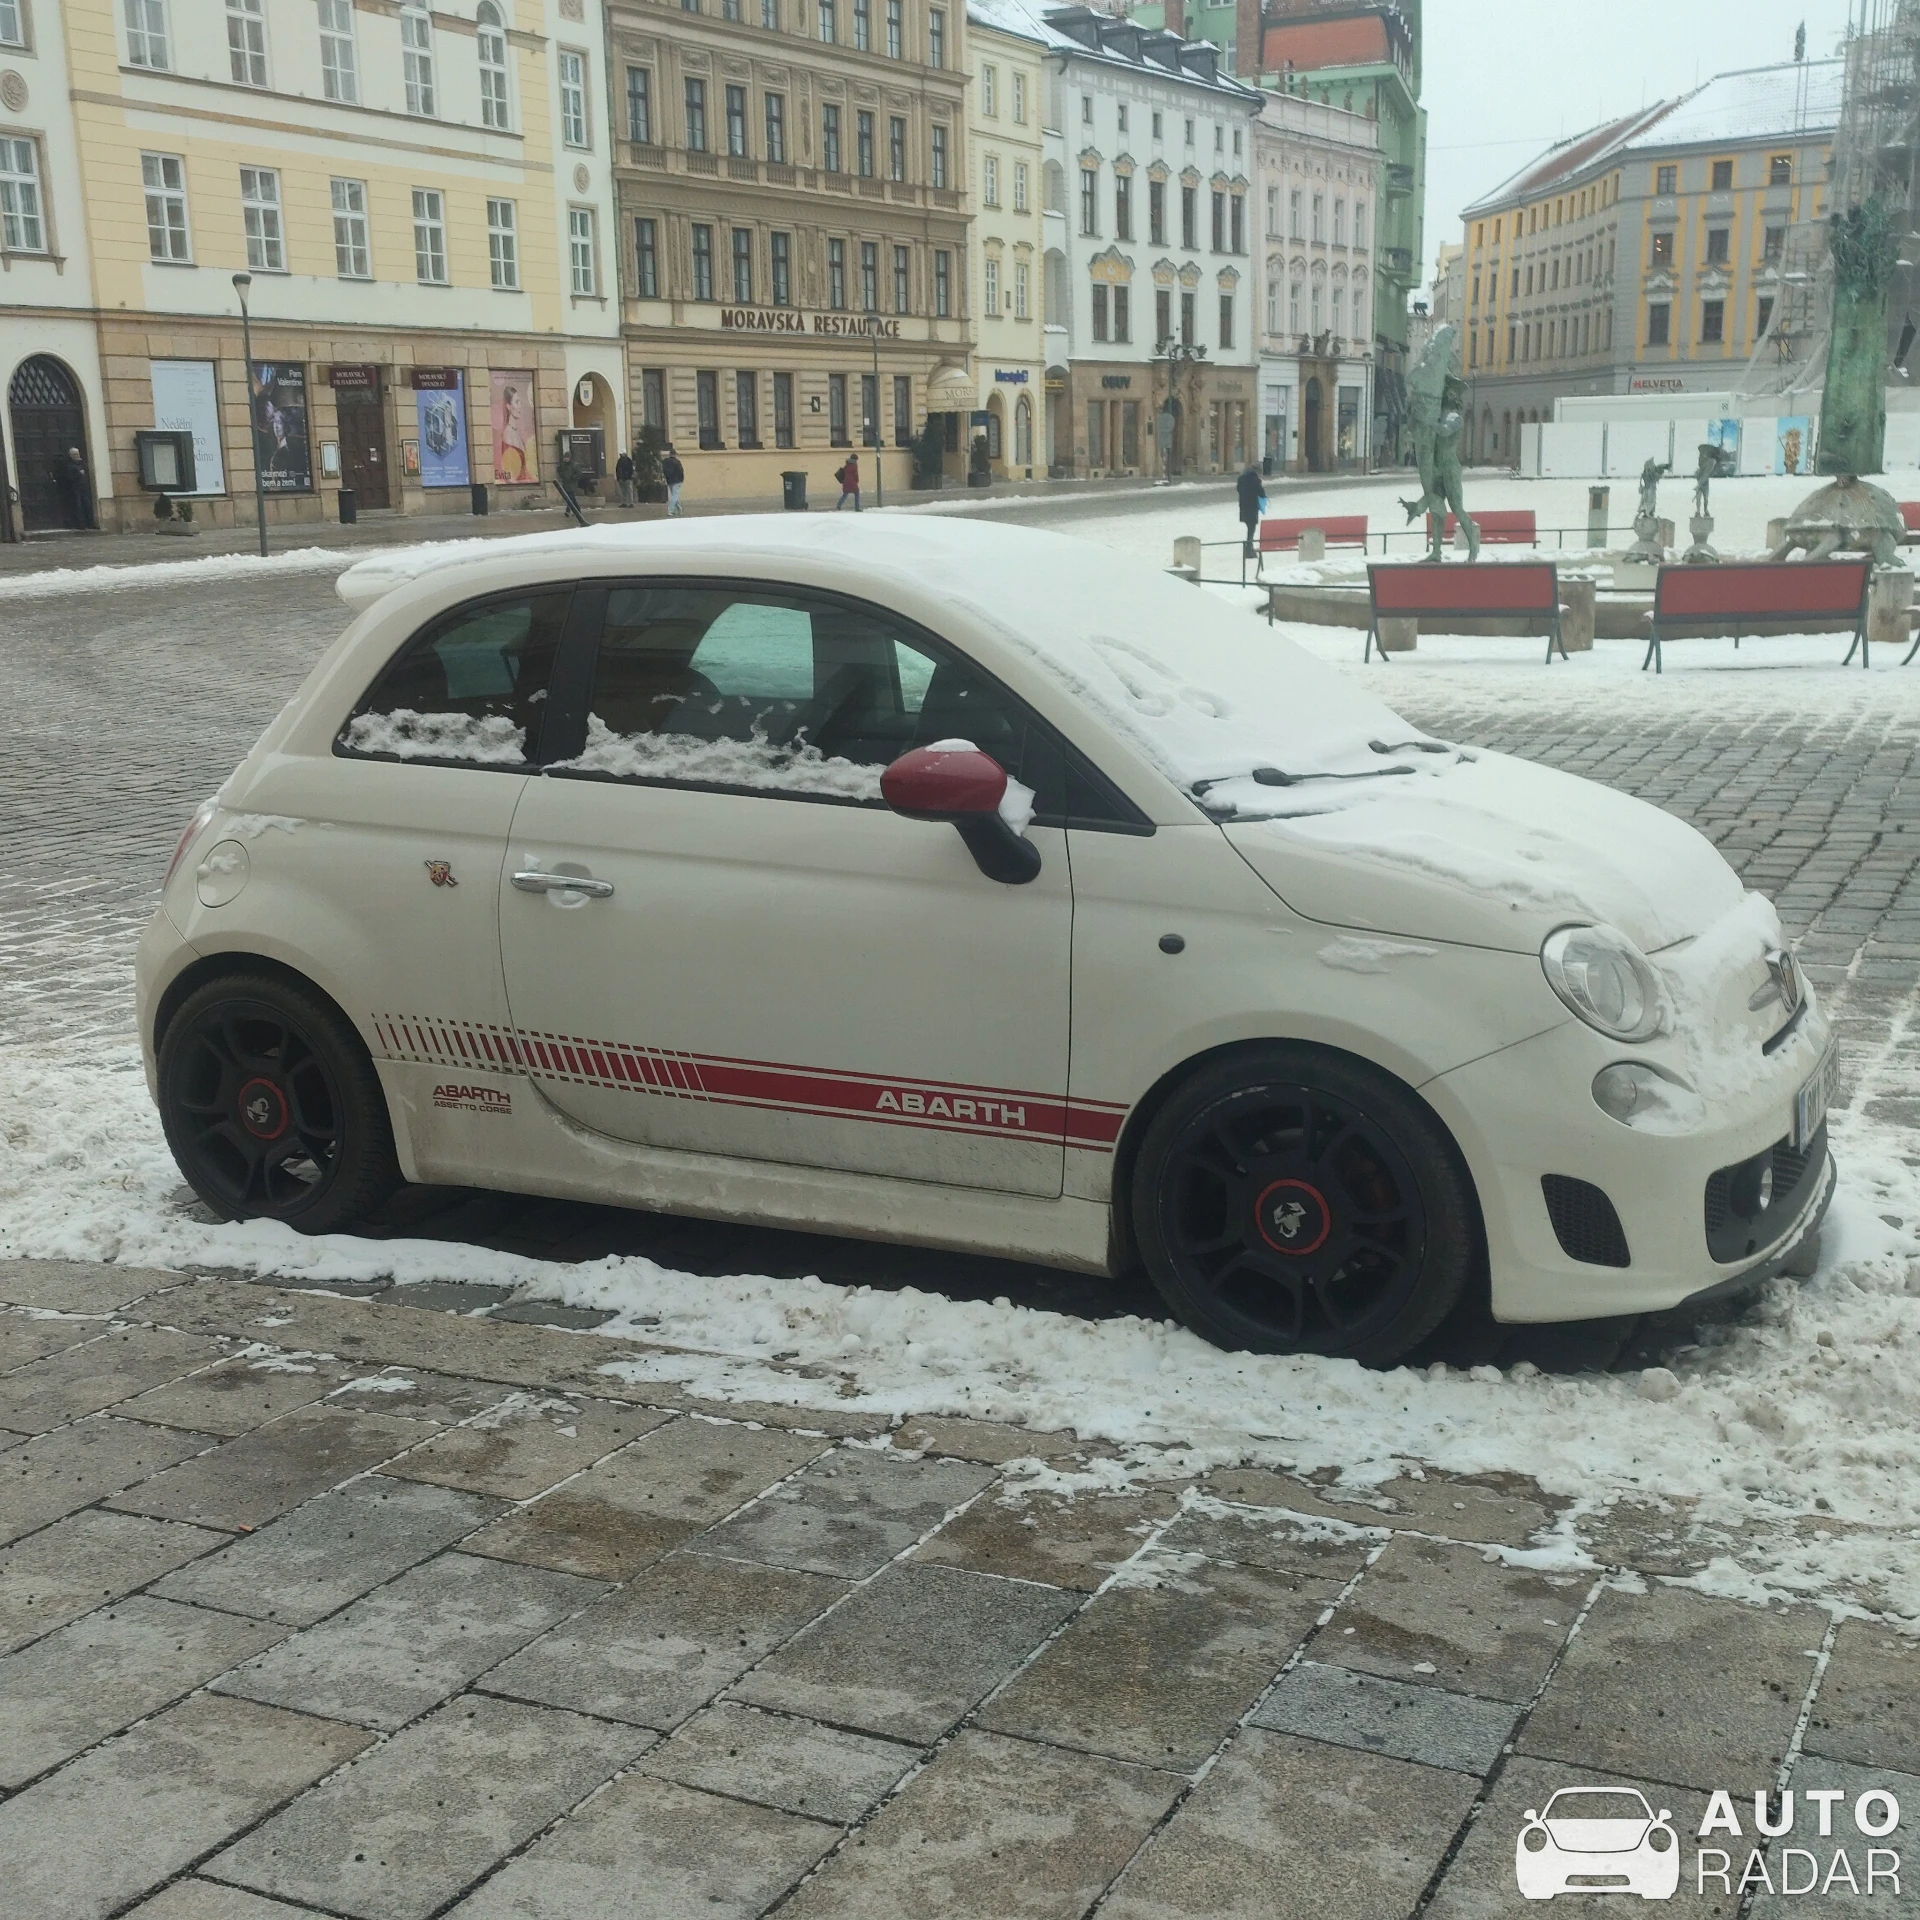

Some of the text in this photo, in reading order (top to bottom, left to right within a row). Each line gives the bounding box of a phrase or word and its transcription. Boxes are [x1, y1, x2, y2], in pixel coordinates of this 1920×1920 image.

[721, 309, 805, 332] MORAVSKÁ
[333, 378, 369, 386] FILHARMONIE
[1632, 379, 1683, 389] HELVETIA
[494, 469, 511, 480] Evita
[433, 1085, 511, 1103] ABARTH
[433, 1101, 513, 1115] ASSETTO CORSE
[876, 1090, 1026, 1127] ABARTH
